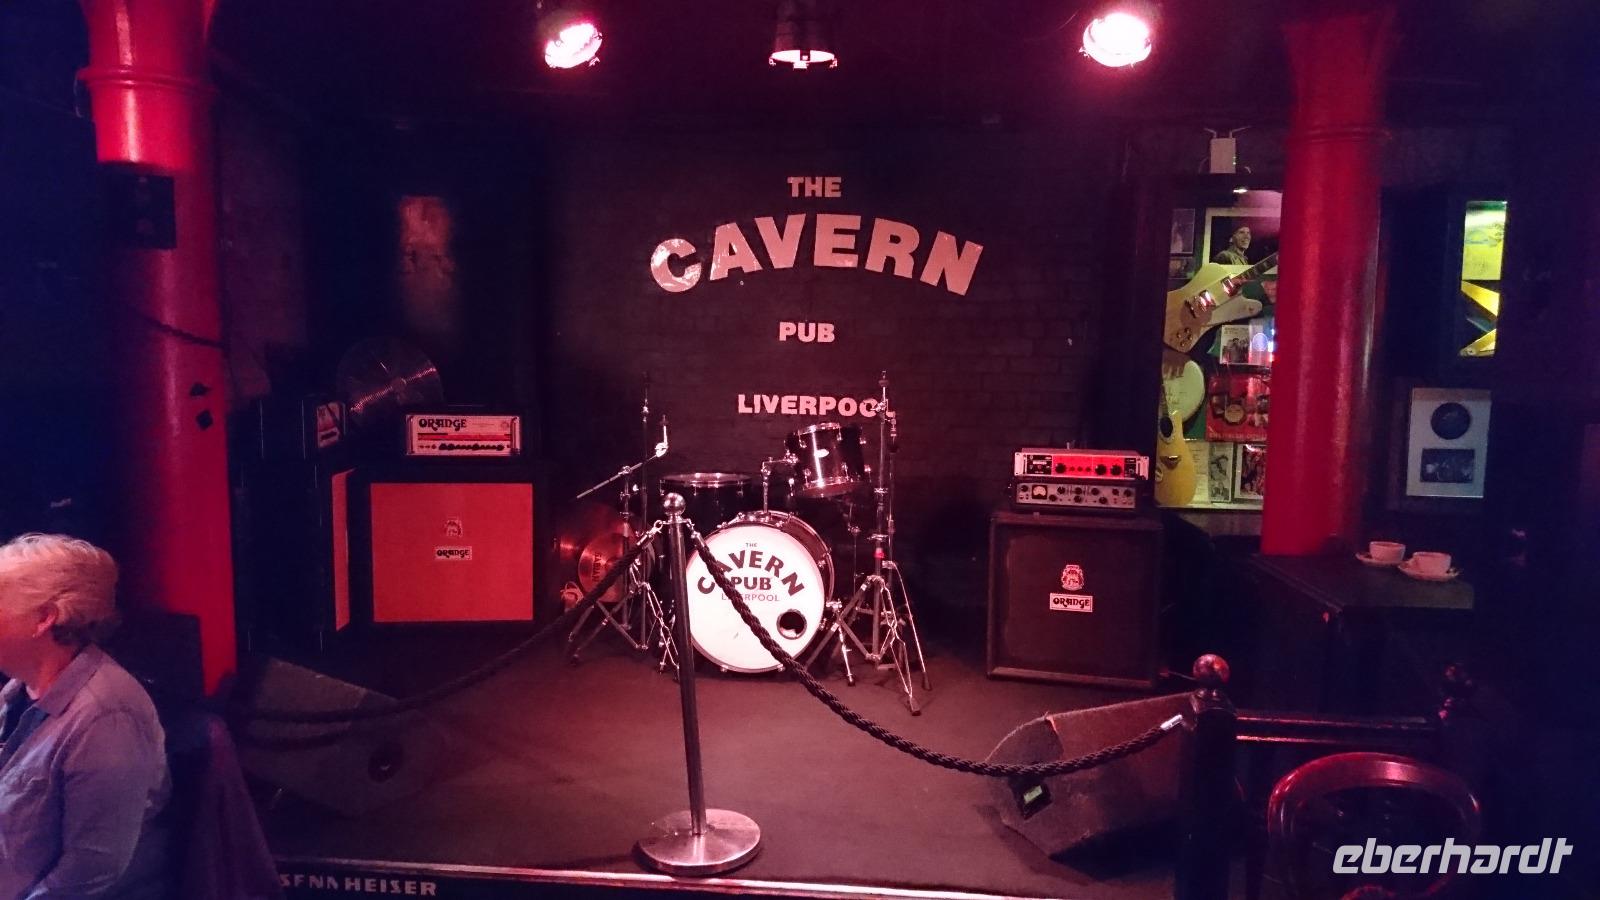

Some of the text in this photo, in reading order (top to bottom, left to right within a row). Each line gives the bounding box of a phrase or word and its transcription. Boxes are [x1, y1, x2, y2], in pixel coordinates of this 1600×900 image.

[787, 176, 842, 198] THE
[650, 213, 984, 297] CAVERN
[778, 321, 836, 343] PUB
[418, 418, 467, 431] ORANGE
[436, 549, 470, 559] ORANGE
[697, 549, 805, 597] CAVERN
[731, 576, 772, 591] PUB
[721, 592, 781, 602] LRPOOL
[1053, 597, 1090, 609] ORANGE
